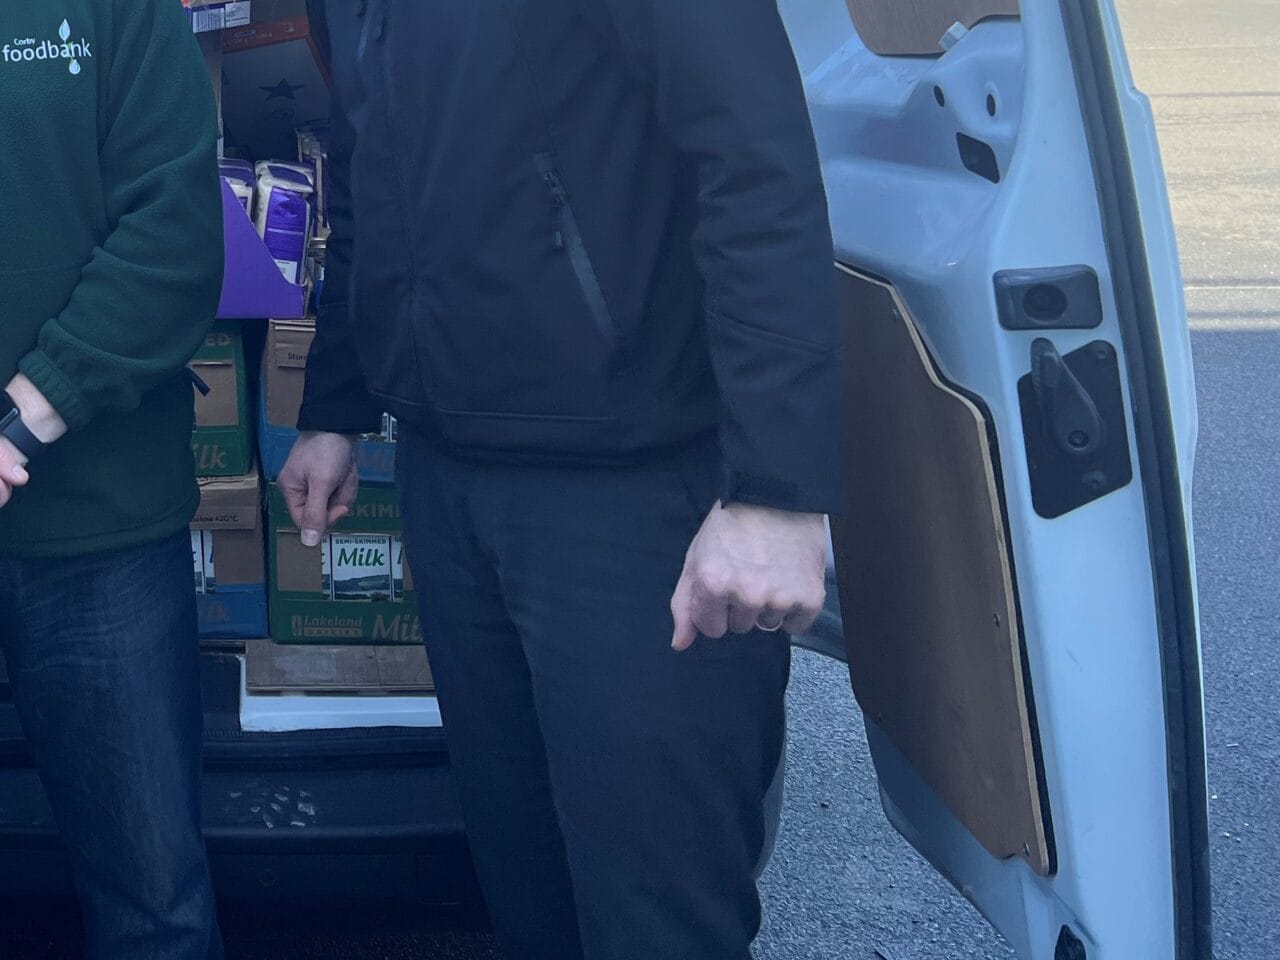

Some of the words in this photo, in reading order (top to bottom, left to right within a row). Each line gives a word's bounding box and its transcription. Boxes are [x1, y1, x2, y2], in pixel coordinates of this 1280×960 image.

[2, 38, 92, 62] foodbank
[13, 37, 36, 46] Corby
[337, 547, 385, 567] Milk
[304, 615, 362, 627] Lakeland
[371, 614, 424, 642] Mil
